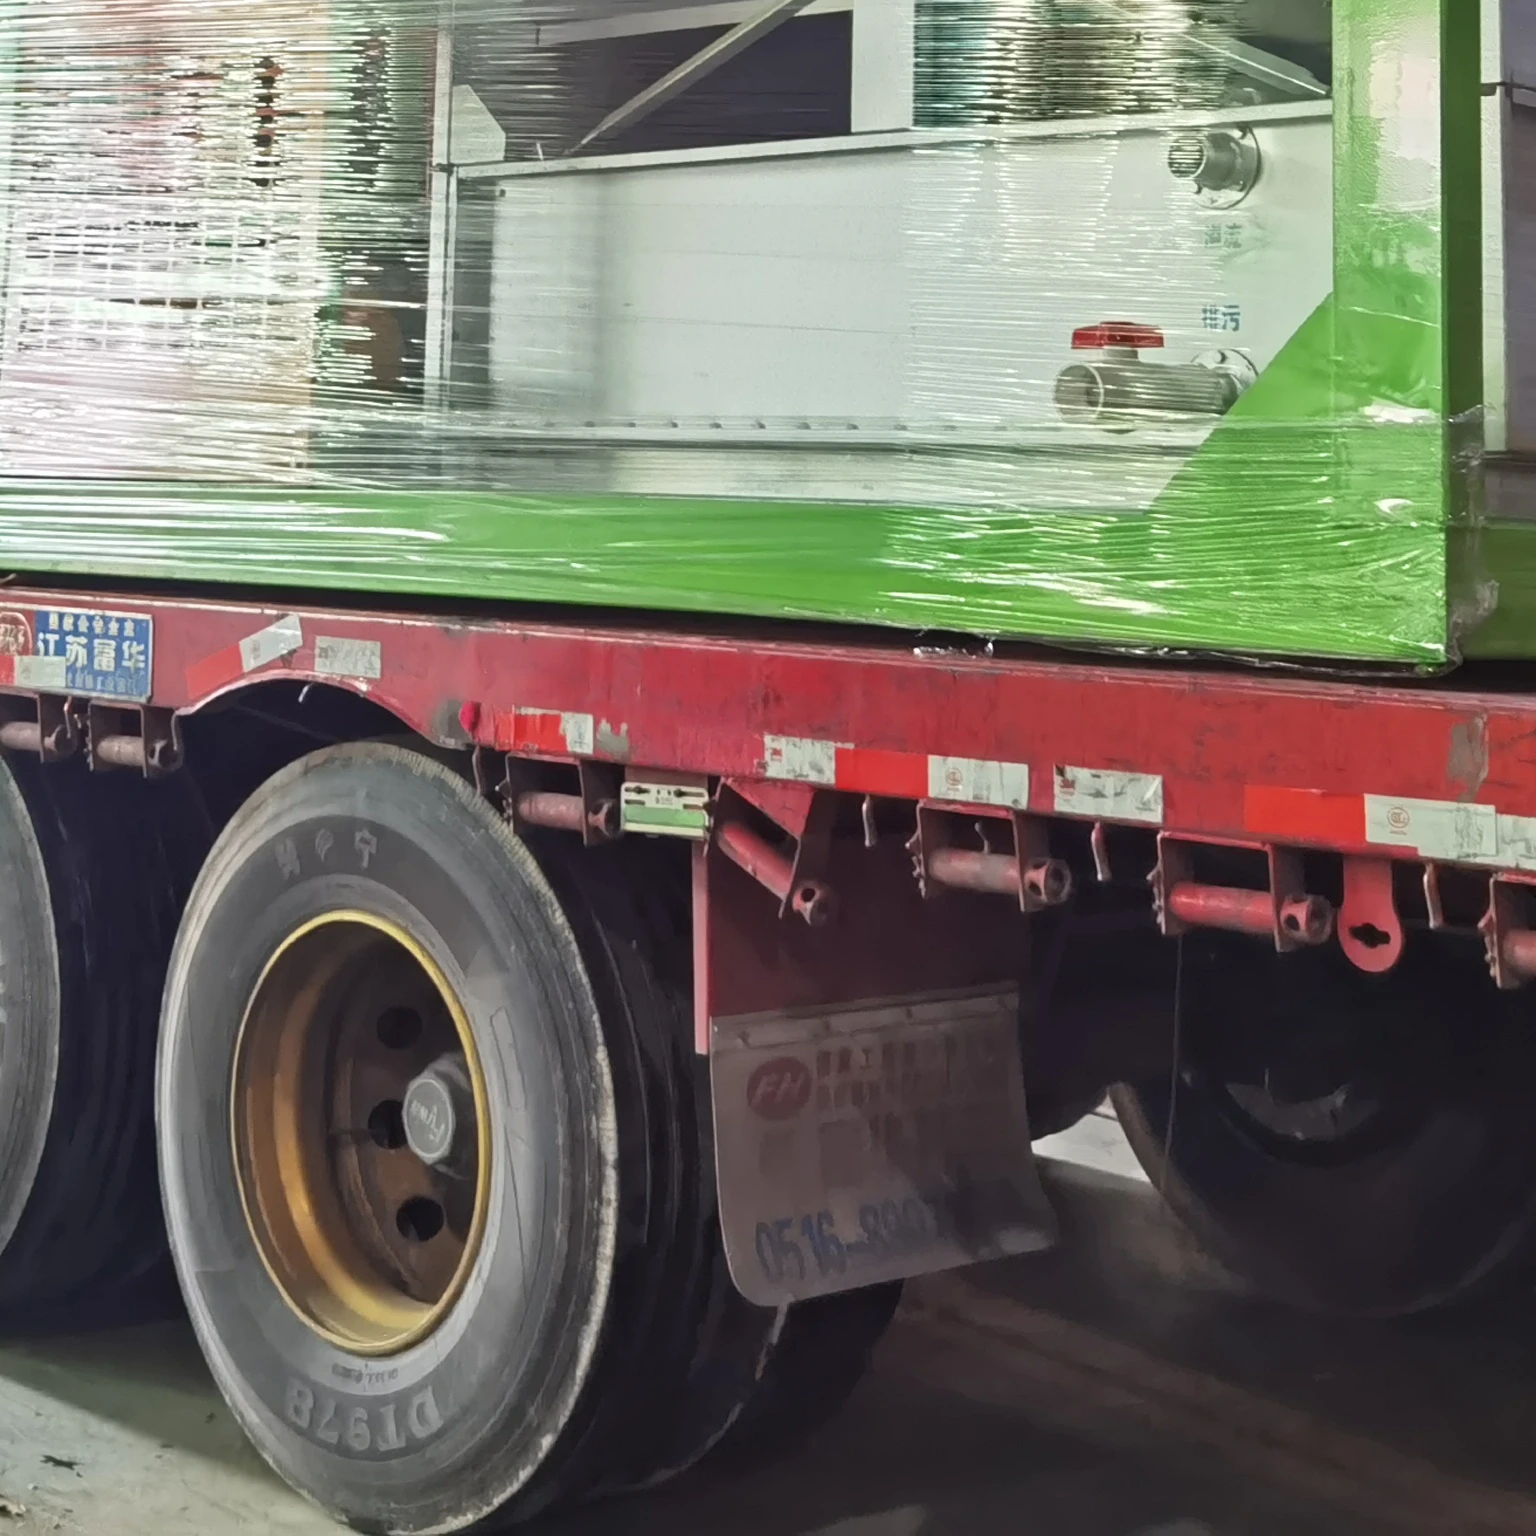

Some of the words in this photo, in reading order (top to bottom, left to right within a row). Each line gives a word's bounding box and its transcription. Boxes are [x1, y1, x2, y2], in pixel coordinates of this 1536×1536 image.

[1201, 303, 1241, 332] 排污
[36, 632, 146, 674] 江苏富华
[284, 1376, 445, 1452] DT978
